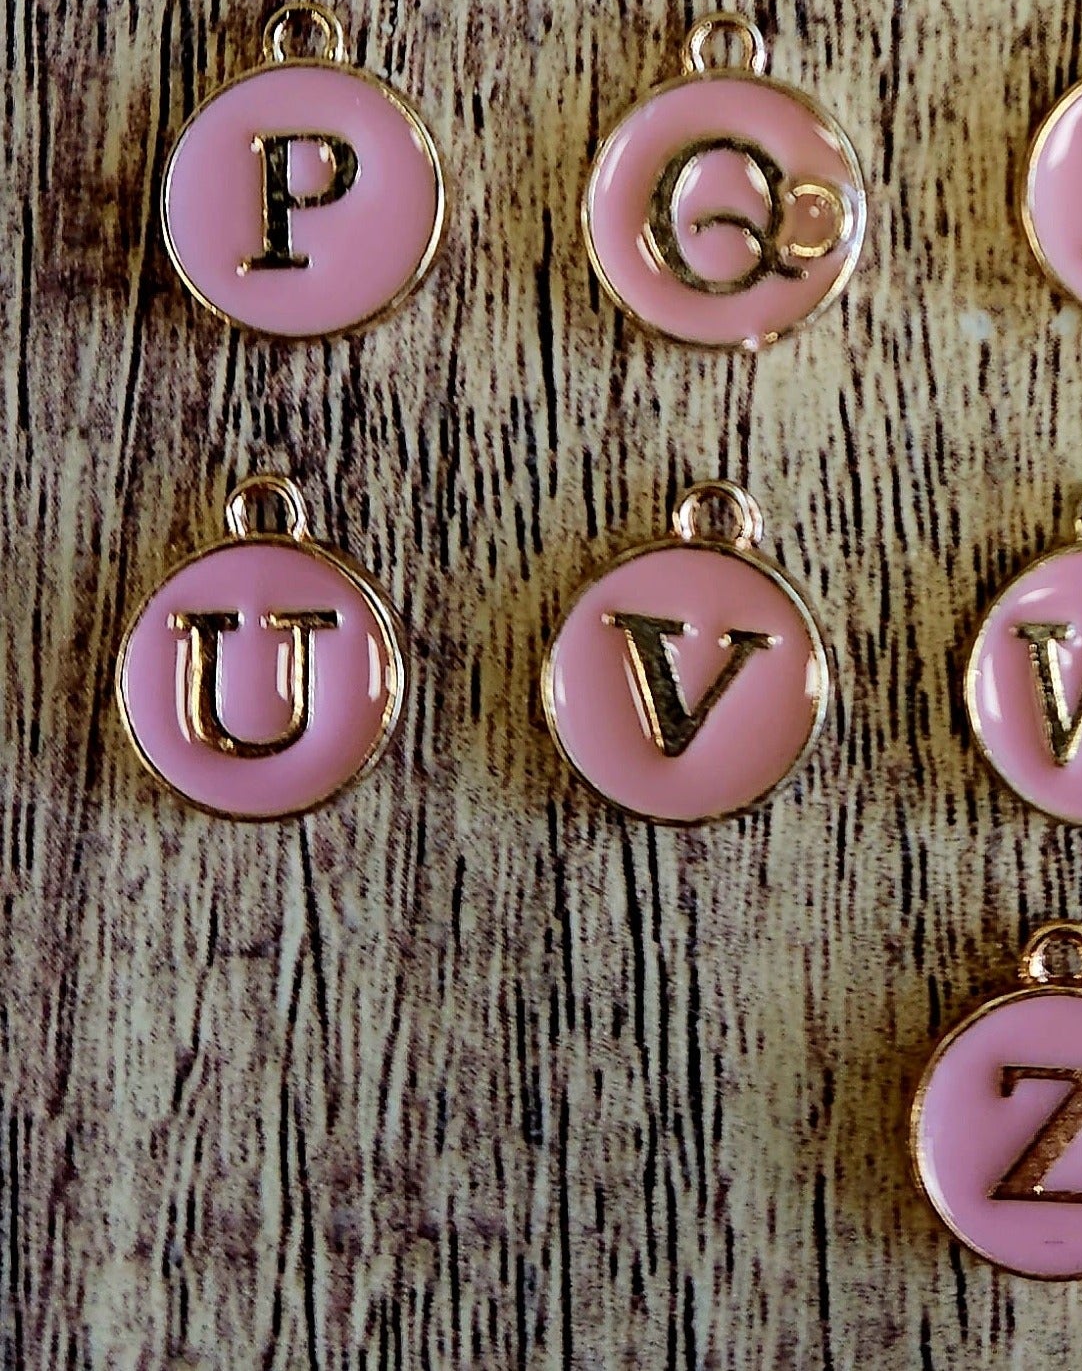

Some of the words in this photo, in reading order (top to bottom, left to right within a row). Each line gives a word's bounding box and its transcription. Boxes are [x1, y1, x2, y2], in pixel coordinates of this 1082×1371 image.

[237, 128, 360, 276] P
[650, 137, 808, 294] Q
[167, 611, 343, 758] U
[601, 612, 777, 757] V
